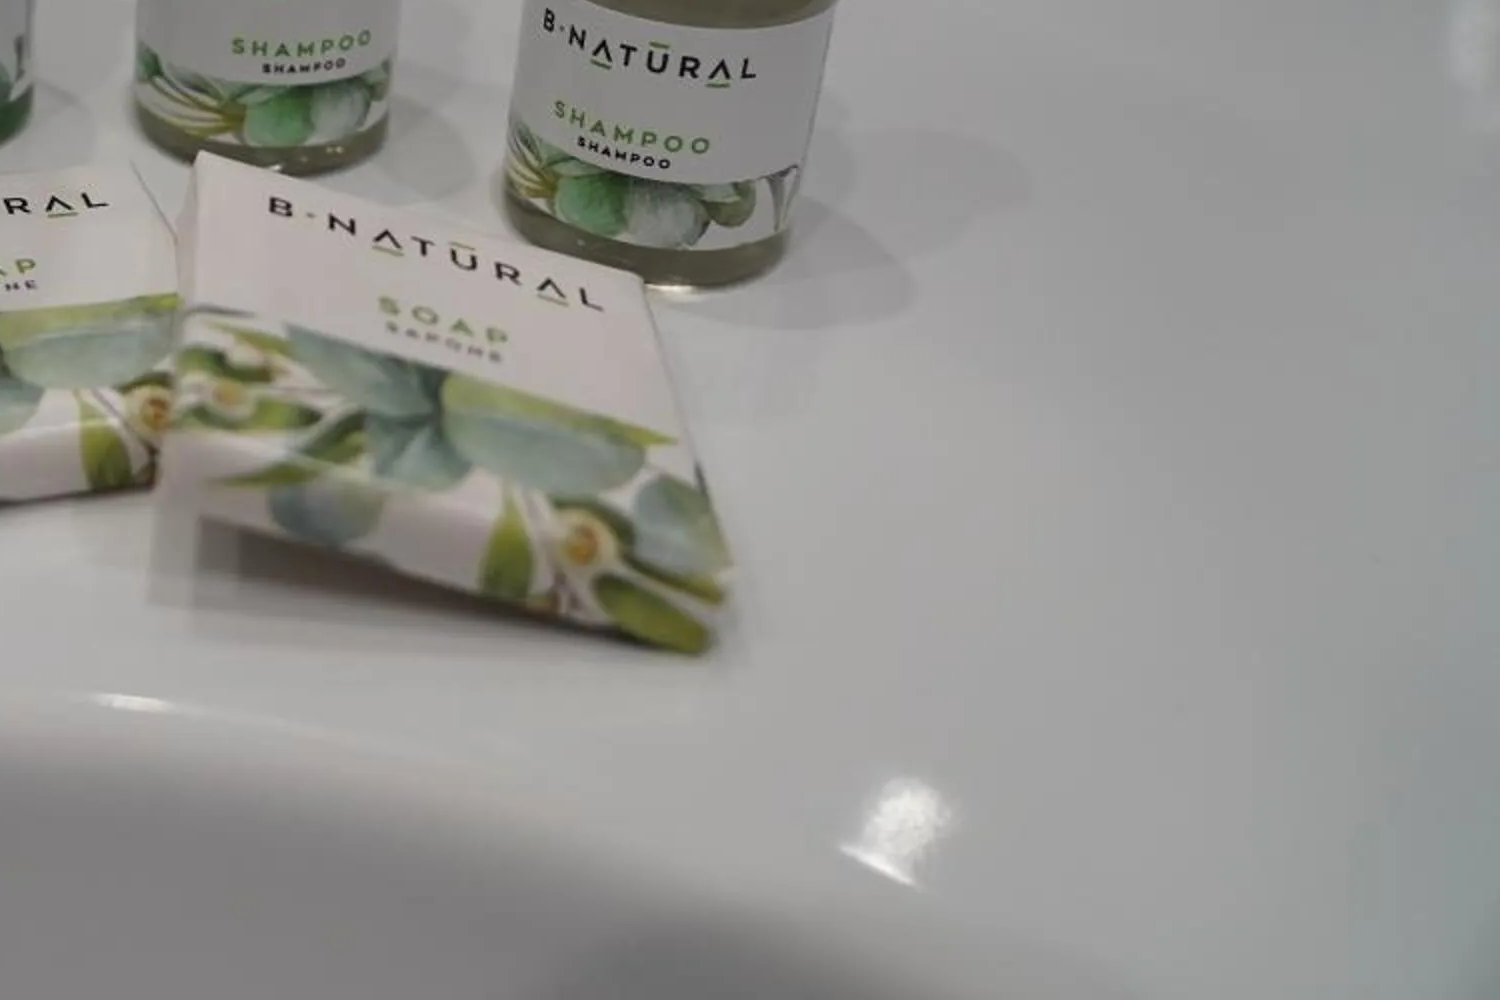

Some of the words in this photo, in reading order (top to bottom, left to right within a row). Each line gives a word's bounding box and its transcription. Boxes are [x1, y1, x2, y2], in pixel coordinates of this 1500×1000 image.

[231, 29, 372, 57] SHAMPOO
[262, 57, 346, 74] SHAMPOO
[553, 100, 711, 154] SHAMPOO
[577, 136, 671, 170] SHAMPOO
[377, 296, 509, 346] SOAP
